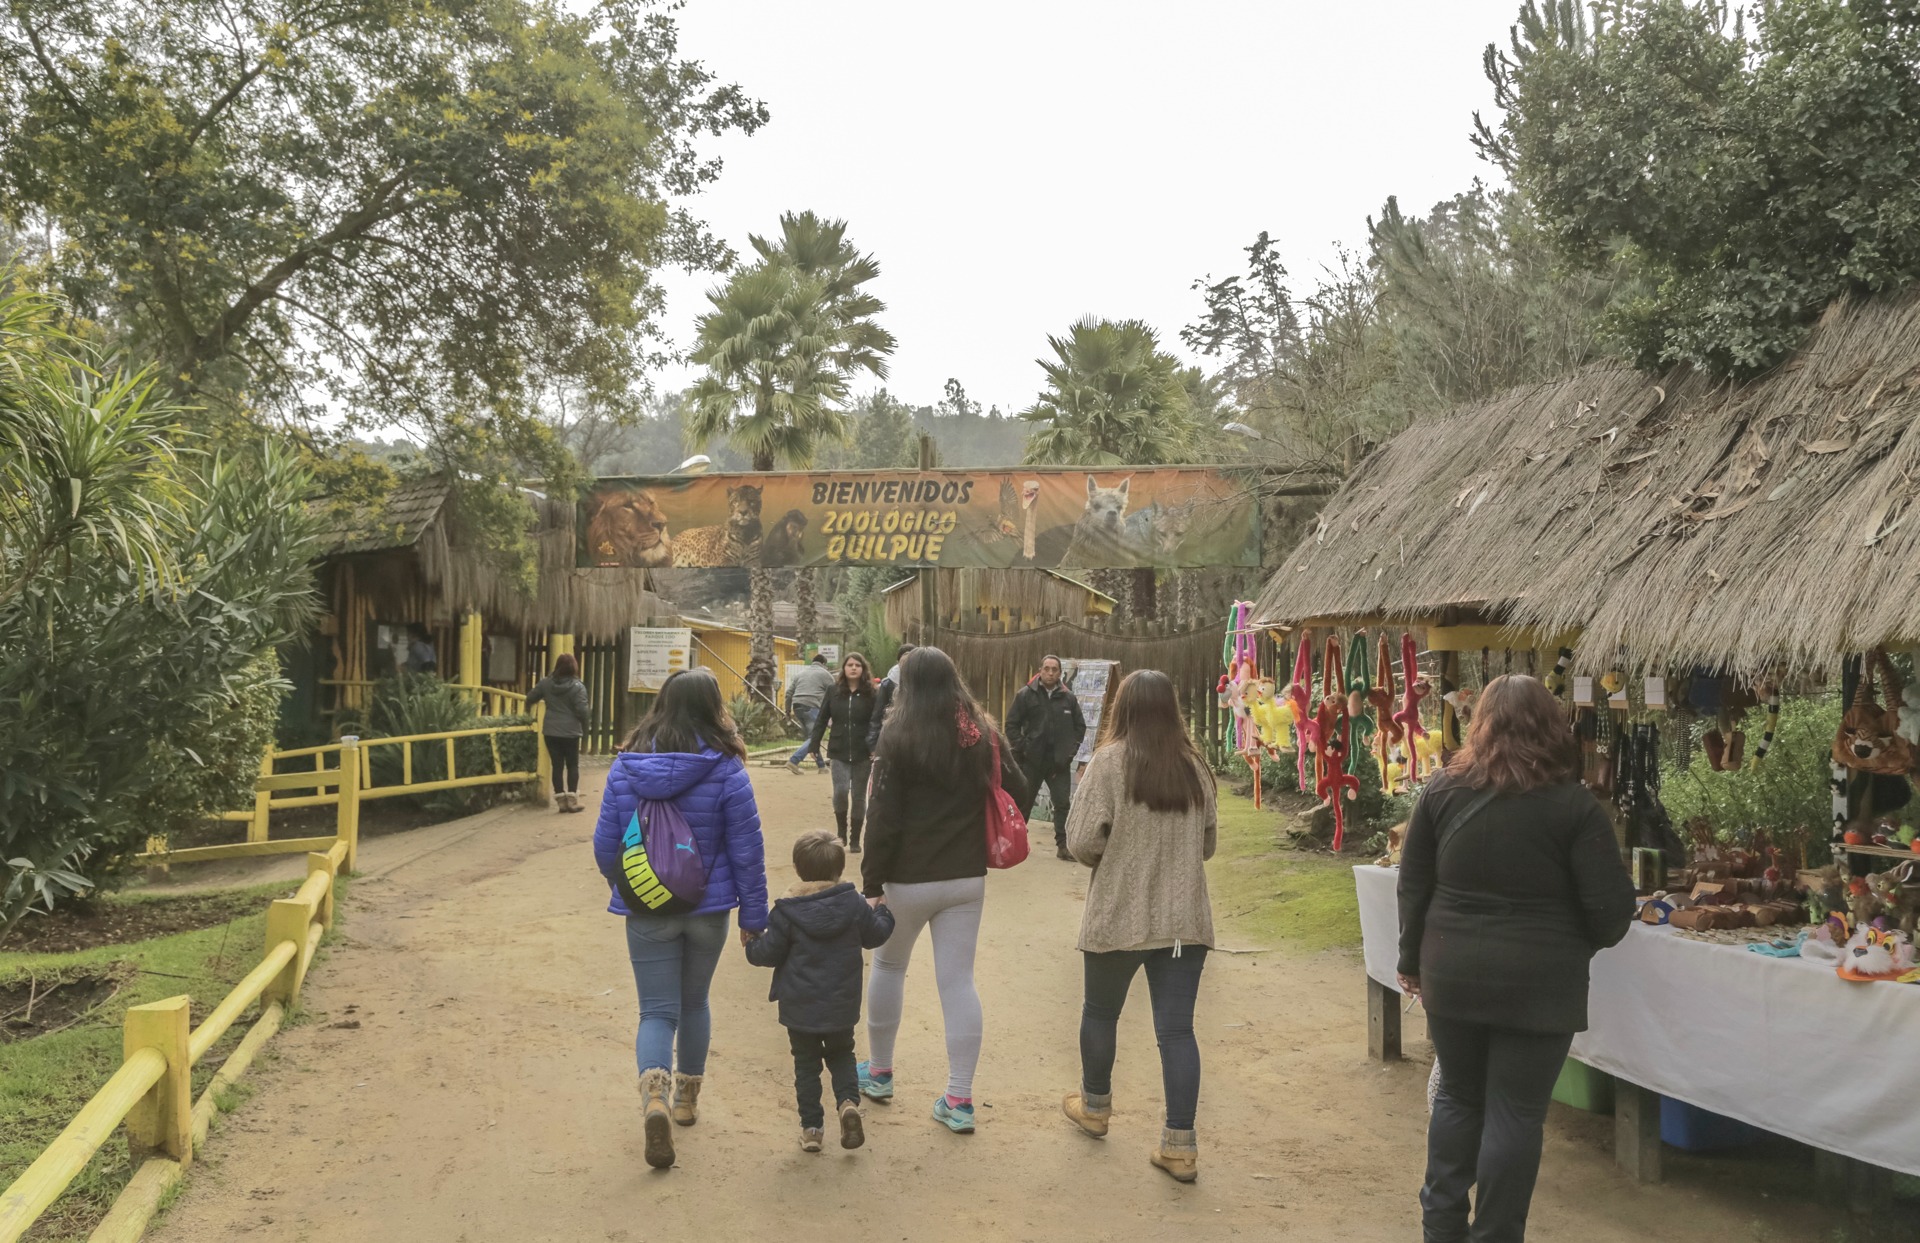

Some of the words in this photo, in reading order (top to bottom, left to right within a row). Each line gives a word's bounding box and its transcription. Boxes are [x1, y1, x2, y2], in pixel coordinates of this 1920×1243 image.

[811, 480, 974, 505] BIENVENIDOS
[826, 528, 945, 561] QUILPUÉ
[621, 808, 673, 910] PUMA
